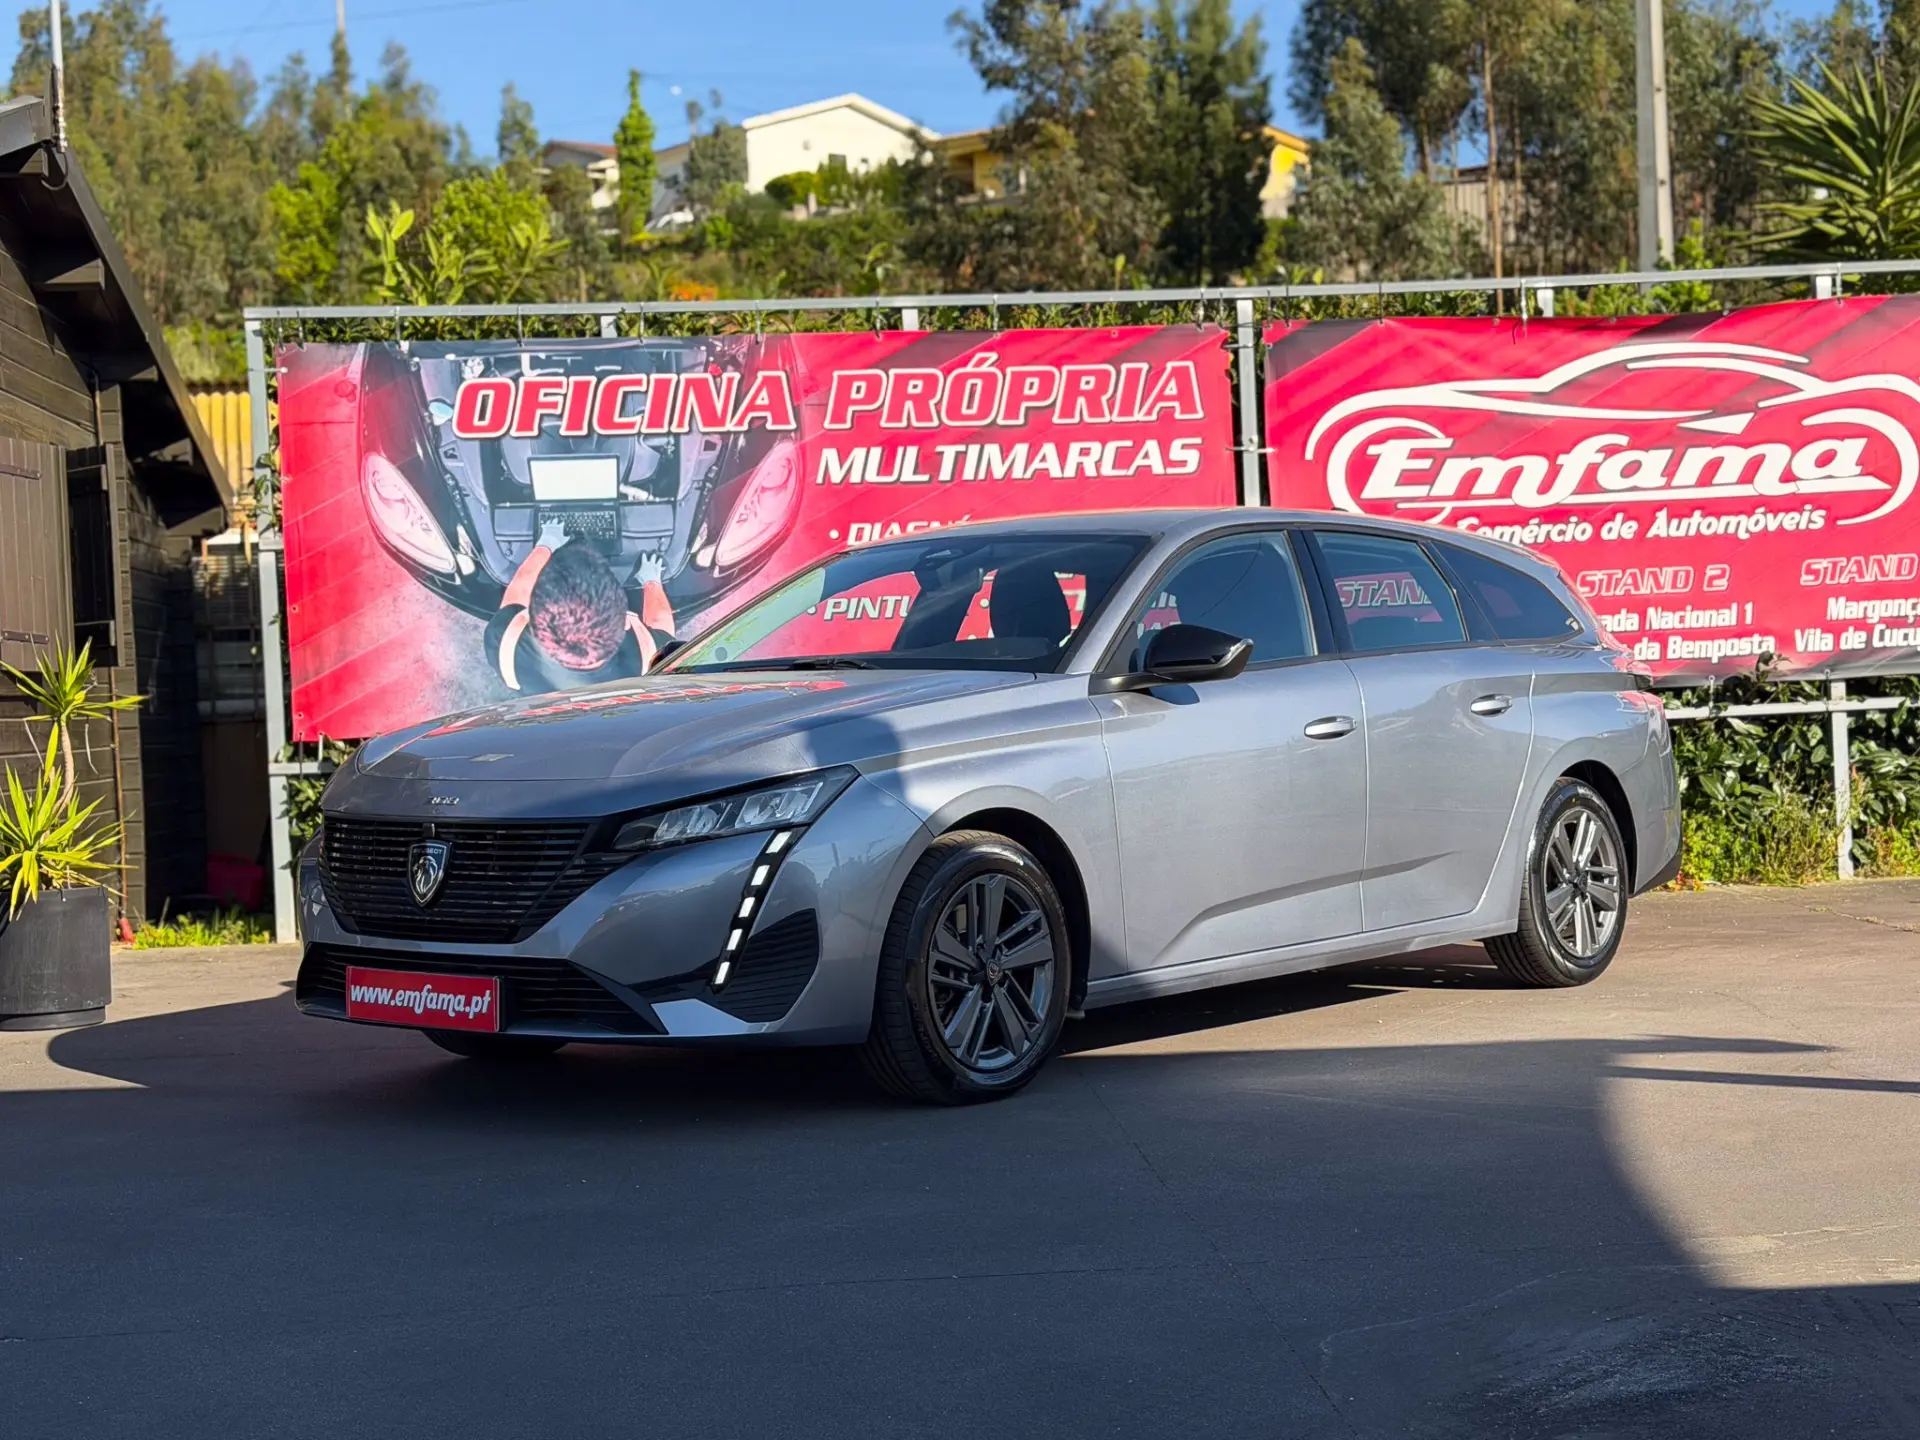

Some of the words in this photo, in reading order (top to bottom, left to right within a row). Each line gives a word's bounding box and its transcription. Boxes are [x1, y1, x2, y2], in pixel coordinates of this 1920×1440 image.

[453, 371, 796, 438] OFICINA
[824, 352, 1204, 429] PRÓPRIA
[816, 437, 1202, 485] MULTIMARCAS
[1360, 434, 1869, 507] Emfama
[1601, 513, 1635, 540] de
[1647, 504, 1826, 544] Automóveis
[1577, 566, 1694, 597] STAND
[1703, 564, 1730, 592] 2
[1800, 553, 1918, 586] STAND
[1335, 579, 1432, 607] STAN
[1597, 608, 1639, 632] ada
[1645, 602, 1738, 631] Nacional
[1744, 601, 1753, 625] 1
[1634, 636, 1660, 661] da
[1667, 634, 1775, 664] Bemposta
[1794, 628, 1834, 652] Vila
[1840, 626, 1867, 650] de
[1872, 623, 1920, 653] Cucu
[351, 984, 491, 1019] www.emfama.pt
